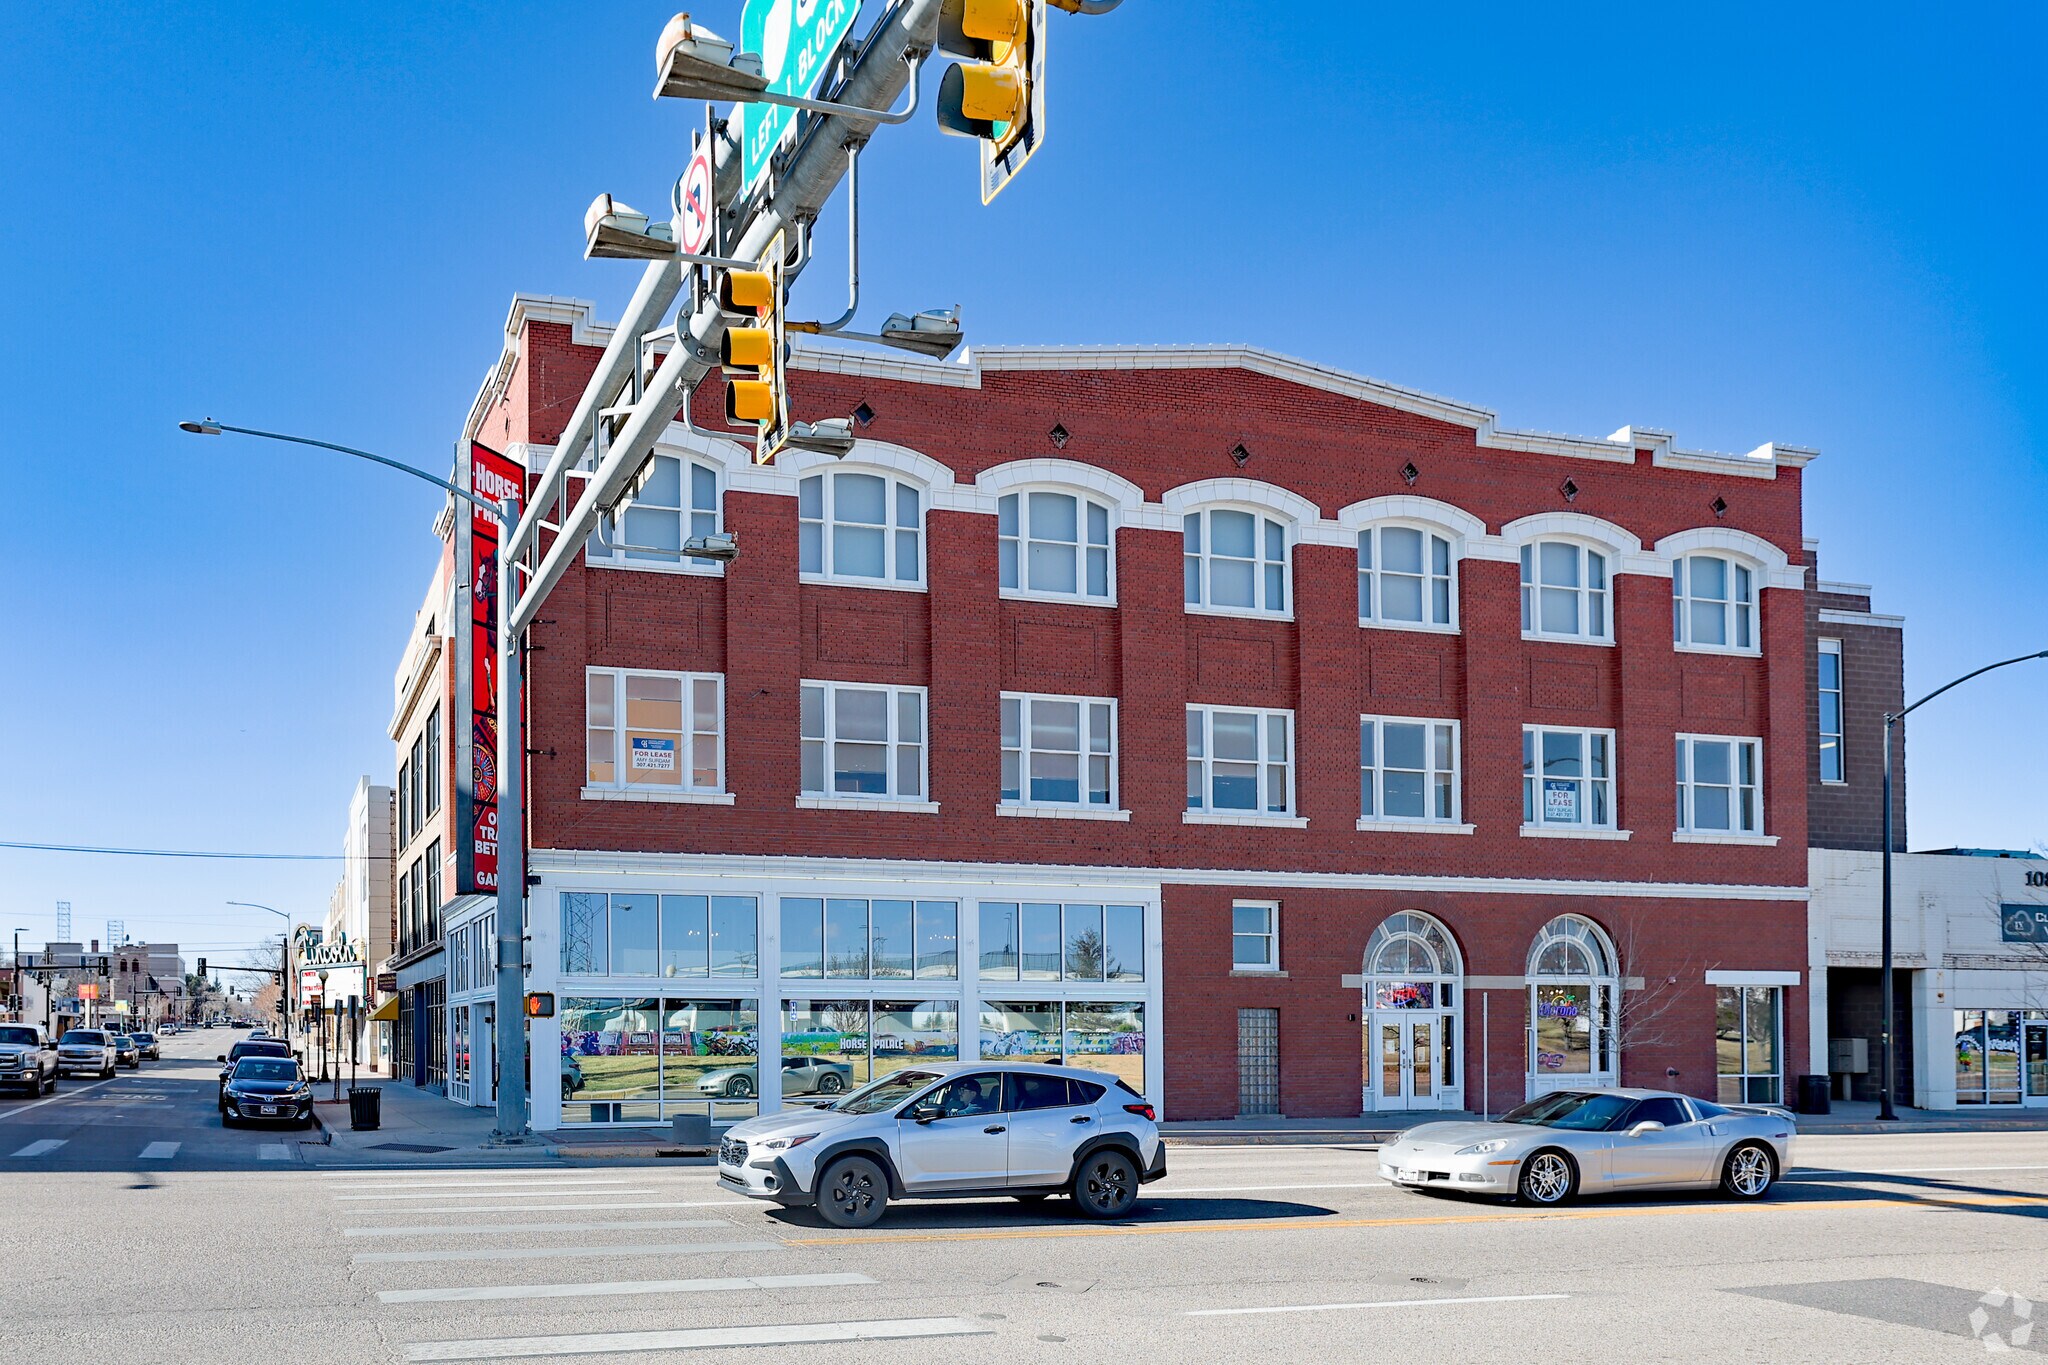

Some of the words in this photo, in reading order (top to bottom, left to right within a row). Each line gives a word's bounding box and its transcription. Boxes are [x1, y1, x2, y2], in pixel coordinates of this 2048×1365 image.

[798, 0, 845, 86] BLOCK
[475, 461, 519, 500] HORSE
[1548, 799, 1573, 807] LEASE
[296, 928, 356, 966] Lincoln
[1538, 1002, 1578, 1017] Corona
[840, 1038, 867, 1050] HORSE
[874, 1039, 904, 1050] PALACE
